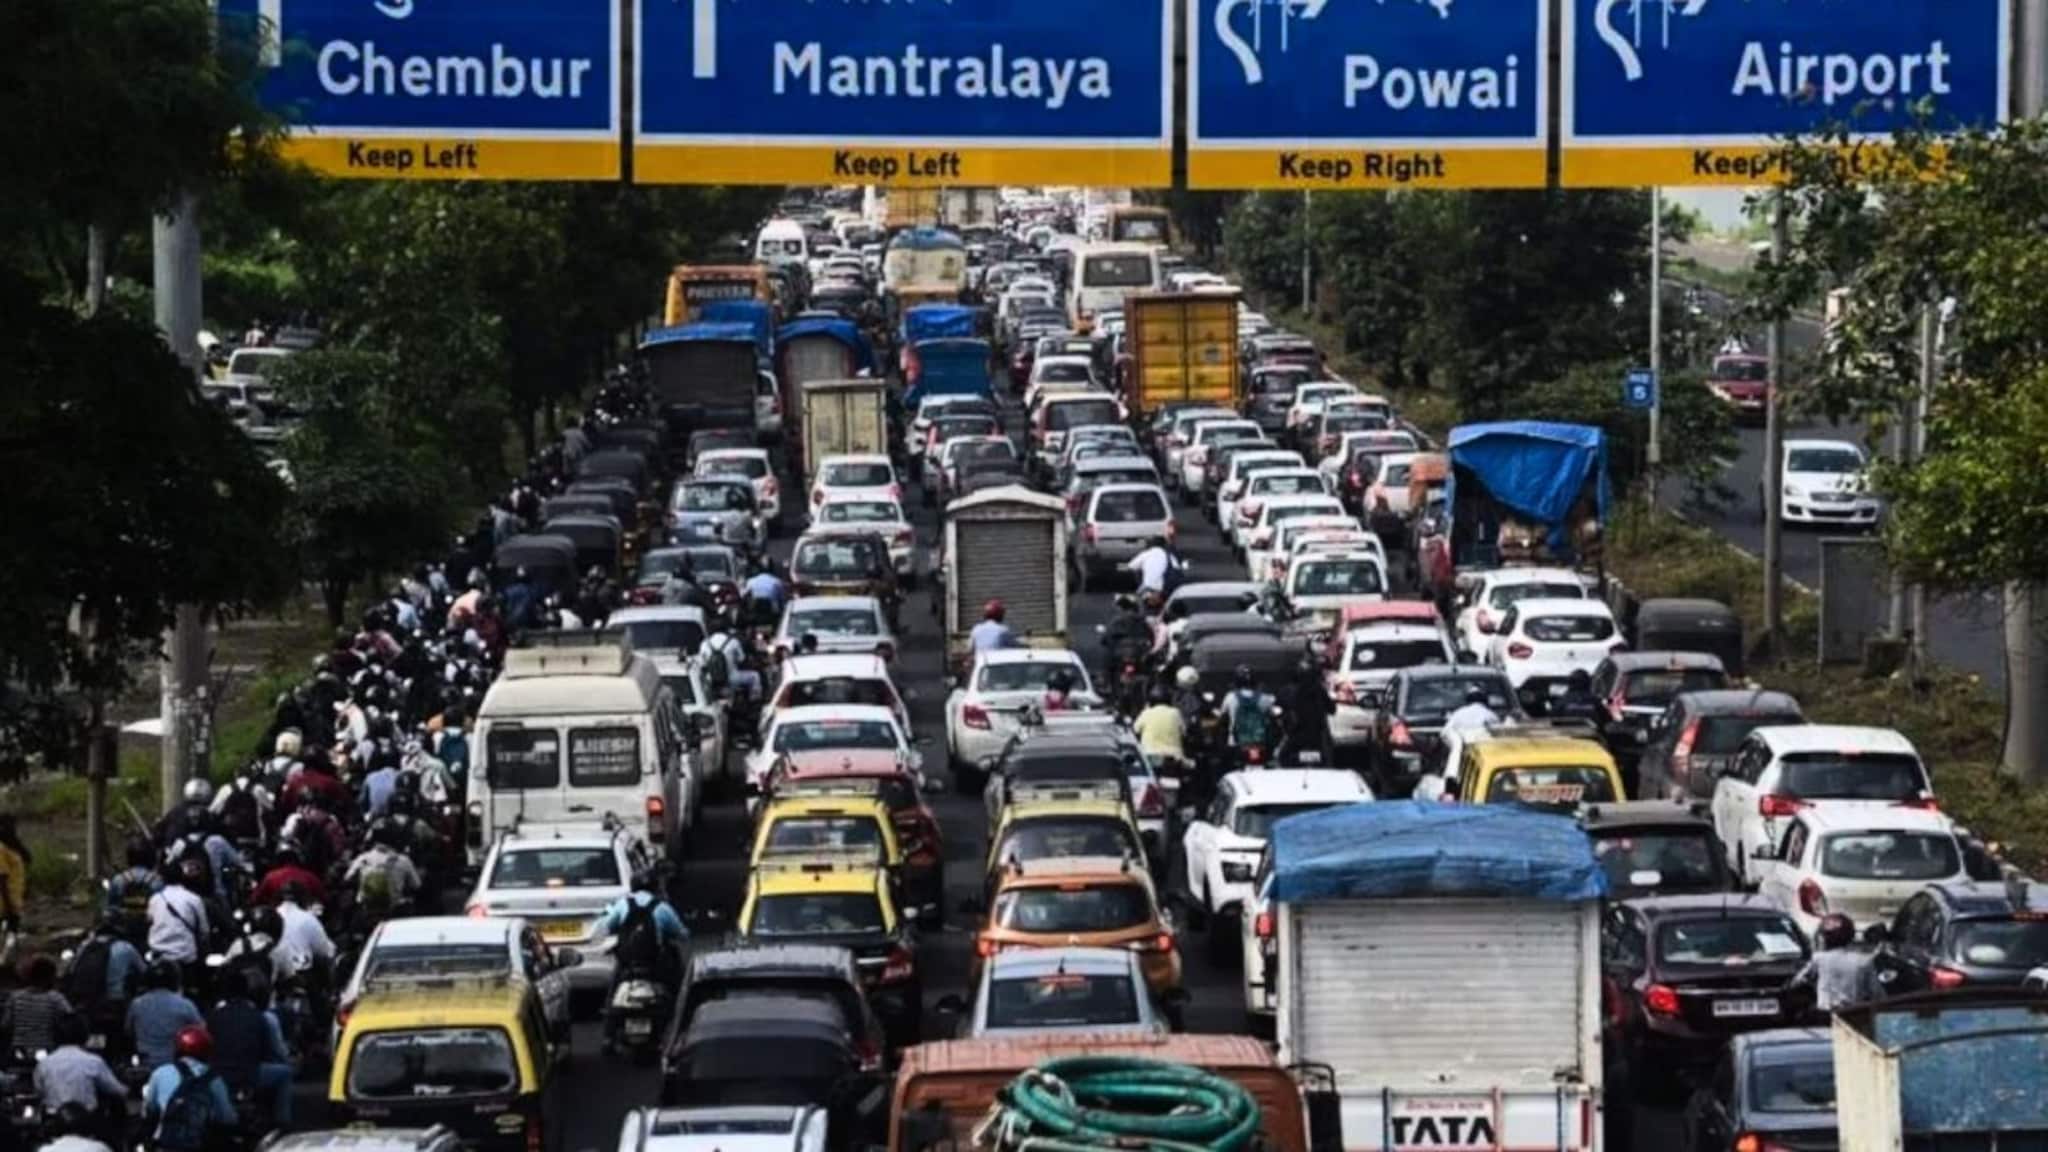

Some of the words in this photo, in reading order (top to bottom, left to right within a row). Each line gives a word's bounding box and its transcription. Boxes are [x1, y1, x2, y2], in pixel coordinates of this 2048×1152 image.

[318, 40, 590, 97] Chembur
[774, 42, 1110, 108] Mantralaya
[1345, 55, 1517, 109] Powai
[1732, 41, 1950, 105] Airport
[348, 142, 415, 171] Keep
[423, 144, 478, 168] Left
[834, 151, 899, 179] Keep
[908, 152, 960, 177] Left
[1279, 153, 1354, 182] Keep
[1364, 153, 1445, 182] Right
[1693, 151, 1768, 179] Keep
[1391, 1116, 1496, 1145] TATA
